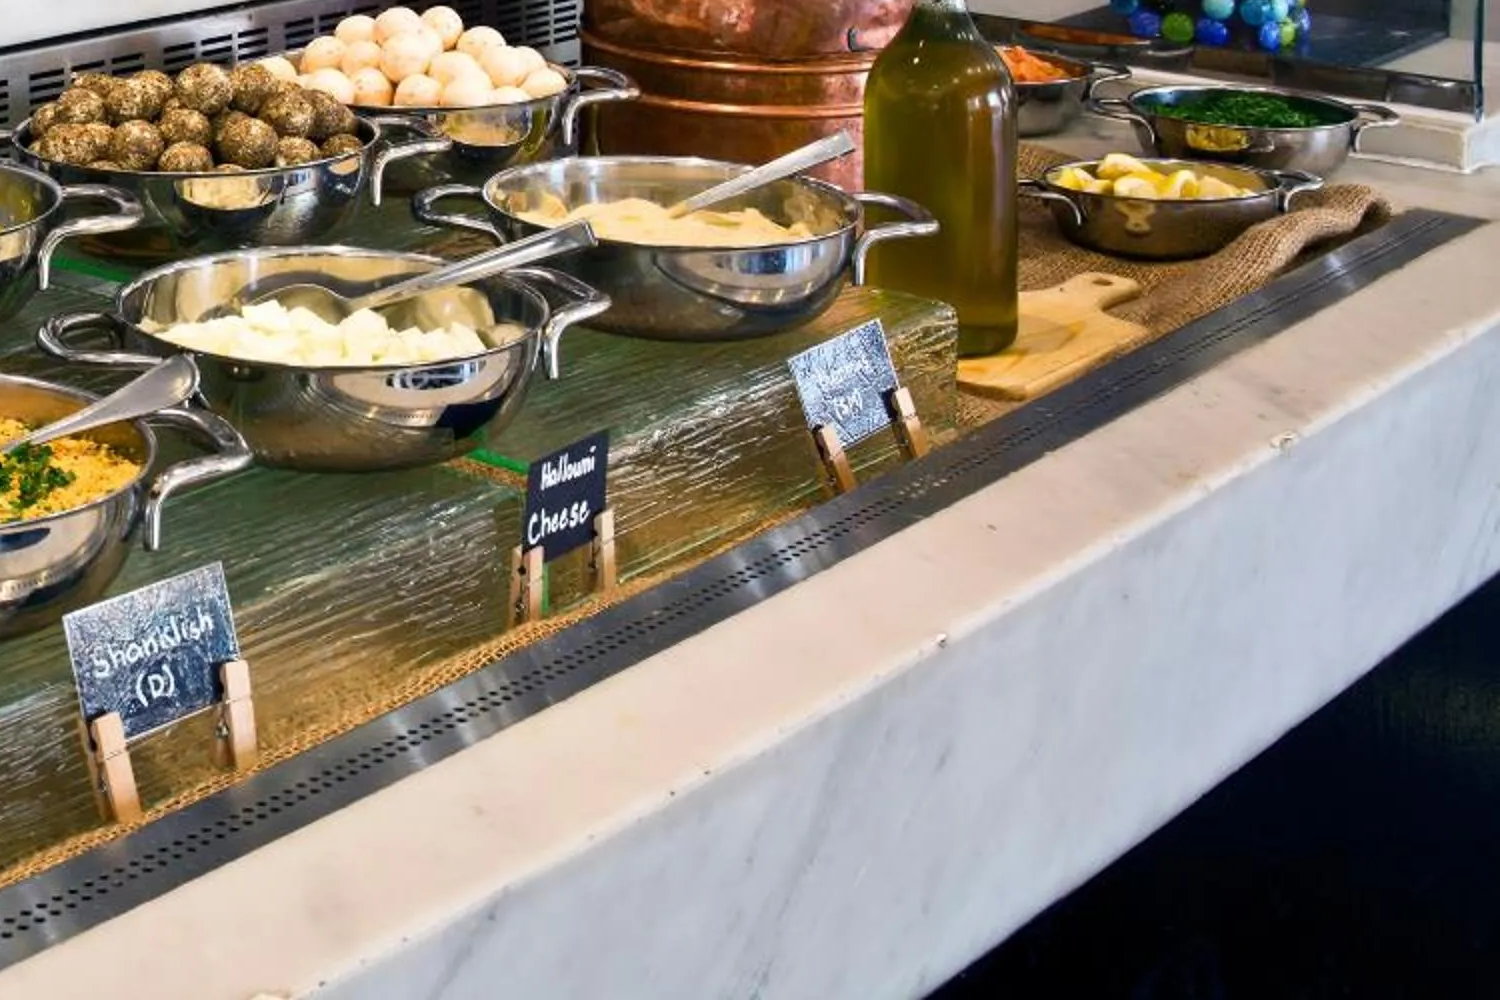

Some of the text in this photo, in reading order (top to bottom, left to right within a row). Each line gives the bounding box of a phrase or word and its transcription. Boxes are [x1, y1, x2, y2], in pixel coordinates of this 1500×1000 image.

[541, 445, 596, 491] Halloumi
[527, 500, 591, 545] Cheese
[92, 606, 214, 679] Shanklish
[135, 663, 175, 708] (D)
